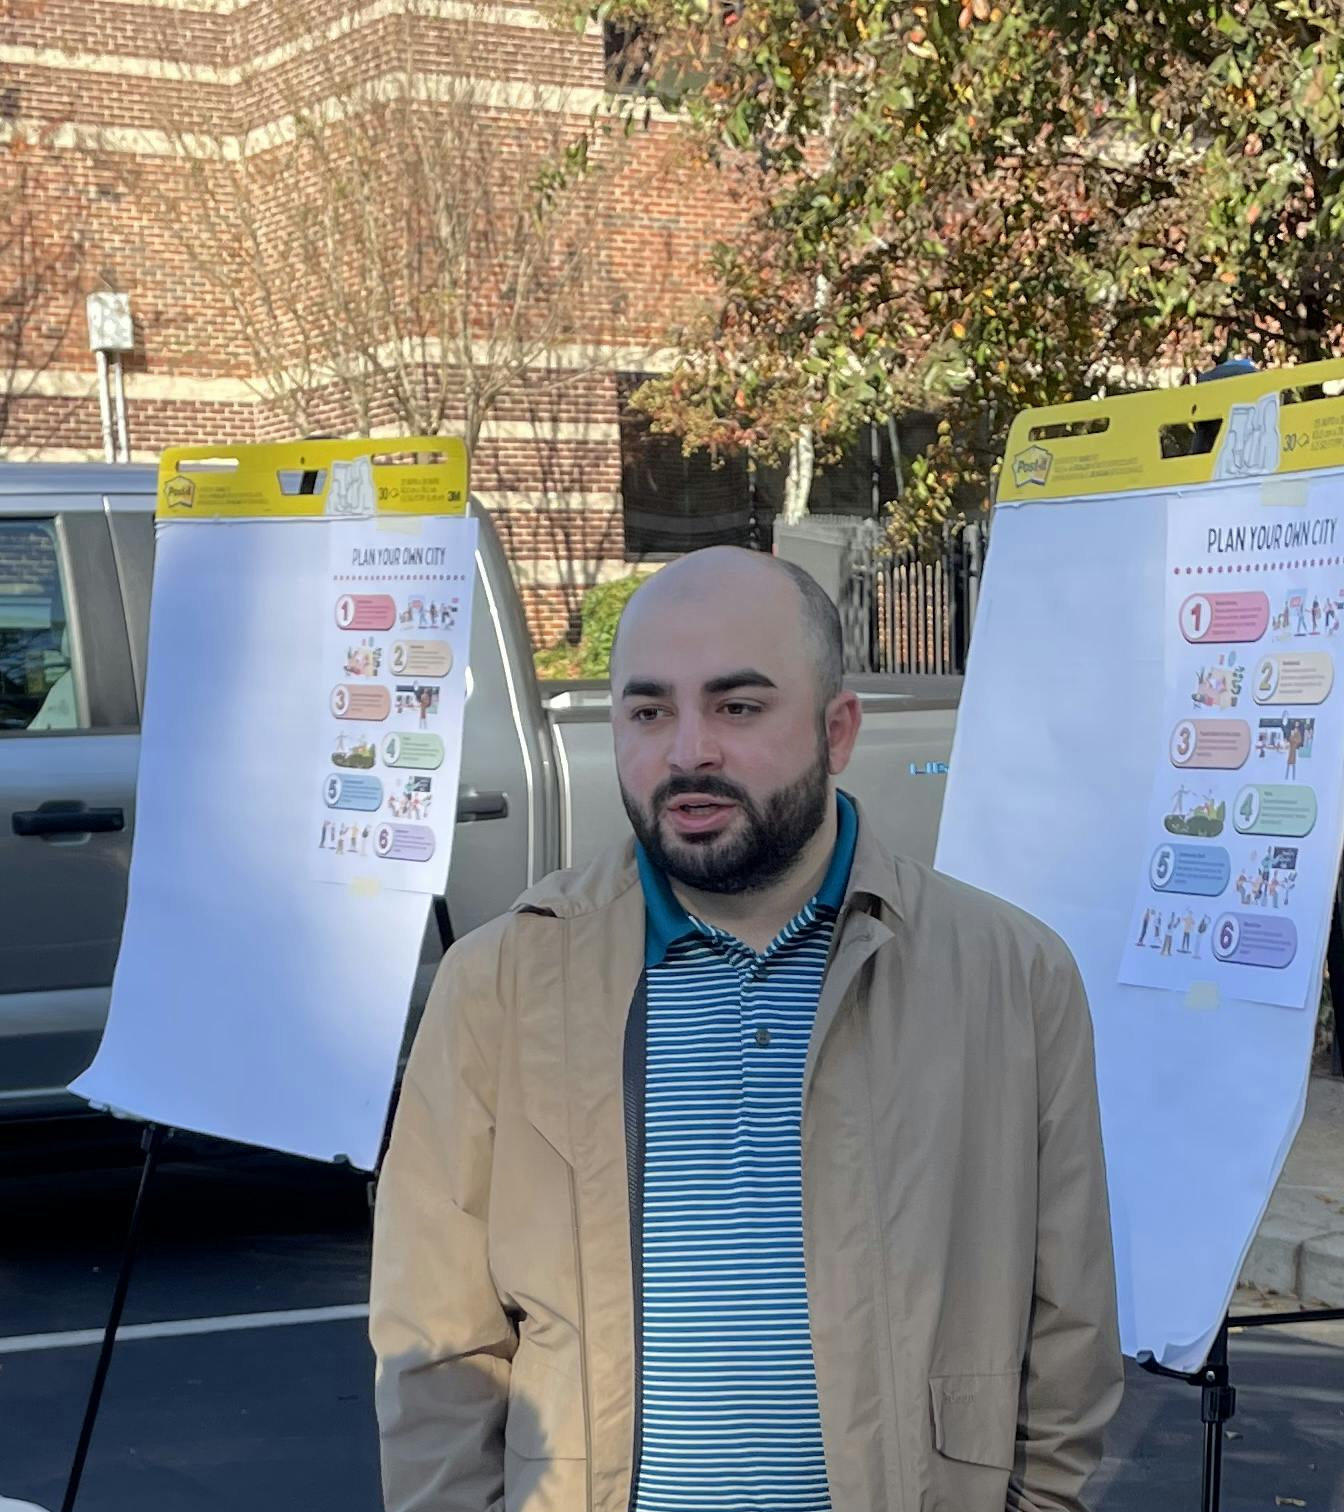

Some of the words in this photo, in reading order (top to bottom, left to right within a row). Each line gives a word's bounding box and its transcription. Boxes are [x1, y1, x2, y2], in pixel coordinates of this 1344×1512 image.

[1207, 526, 1247, 553] PLAN
[1249, 523, 1283, 550] YOUR
[1284, 521, 1311, 547] OWN
[1311, 518, 1339, 544] CITY
[352, 548, 377, 566] PLAN
[376, 548, 401, 566] YOUR
[401, 548, 425, 566] OWN
[424, 547, 447, 565] CITY
[341, 602, 350, 622] 1
[1189, 602, 1203, 632] 1
[394, 645, 404, 667] 2
[1258, 663, 1273, 691] 2
[335, 690, 345, 711] 3
[386, 738, 397, 759] 4
[1176, 727, 1190, 756] 3
[327, 781, 337, 800] 5
[1239, 792, 1254, 822] 4
[378, 828, 389, 849] 6
[1156, 851, 1171, 880] 5
[1219, 919, 1235, 949] 6
